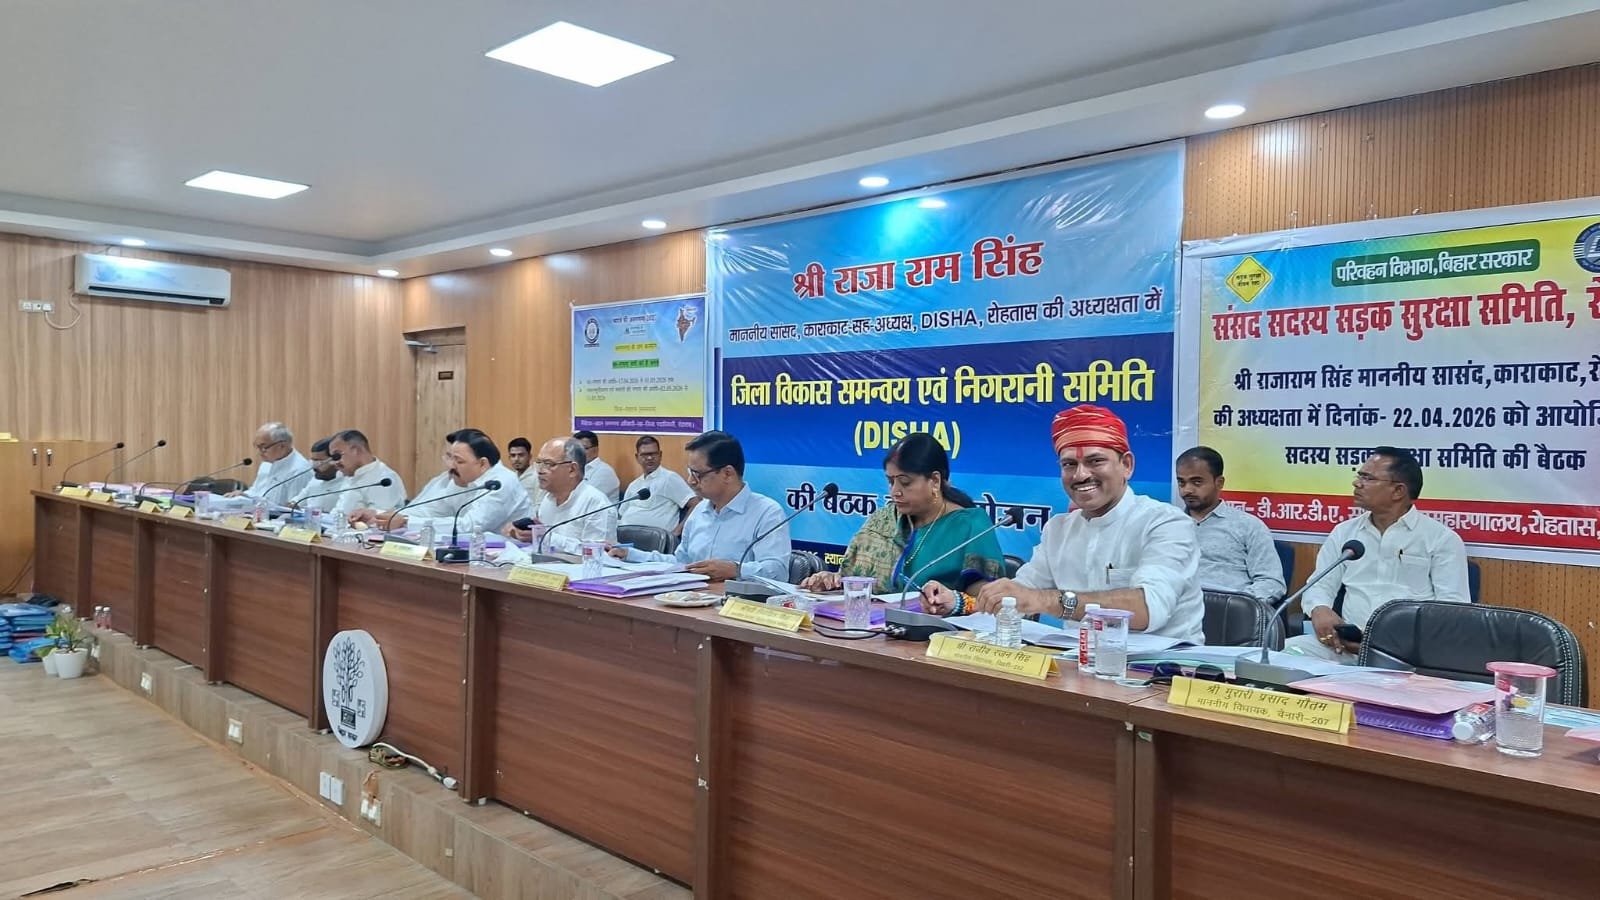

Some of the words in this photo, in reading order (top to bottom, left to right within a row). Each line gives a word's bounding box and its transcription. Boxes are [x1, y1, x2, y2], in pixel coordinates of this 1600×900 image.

[794, 263, 825, 298] श्री
[834, 262, 895, 293] राजा
[906, 253, 961, 286] राम
[972, 236, 1044, 279] सिंह
[1336, 261, 1387, 281] परिवहन
[1479, 248, 1534, 270] सरकार
[729, 323, 767, 342] माननीय
[922, 310, 983, 328] DISHA,
[988, 302, 1037, 323] रोहतास
[1043, 296, 1063, 319] की
[1070, 295, 1140, 317] अध्यक्षता
[1144, 287, 1163, 311] में
[1212, 304, 1262, 340] संसद
[1267, 306, 1330, 337] सदस्य
[1335, 301, 1395, 340] सड़क
[1400, 295, 1472, 341] सुरक्षा
[1478, 280, 1575, 328] समिति,
[731, 374, 770, 406] जिला
[775, 373, 832, 405] विकास
[838, 378, 911, 405] समन्वय
[917, 367, 948, 405] एवं
[955, 363, 1055, 403] निगरानी
[1062, 358, 1155, 402] समिति
[1234, 368, 1252, 390] श्री
[1257, 371, 1317, 389] राजाराम
[1322, 364, 1353, 388] सिंह
[1358, 361, 1427, 387] माननीय
[1213, 405, 1233, 426] की
[1237, 409, 1303, 427] अध्यक्षता
[1307, 404, 1322, 426] में
[1326, 403, 1386, 426] दिनांक-
[1393, 407, 1496, 427] 22.04.2026
[1502, 400, 1530, 426] को
[1285, 446, 1331, 464] सदस्य
[1437, 443, 1497, 468] समिति
[1502, 443, 1530, 469] की
[1534, 443, 1587, 470] बैठक
[787, 483, 816, 511] की
[1206, 684, 1220, 695] श्री
[1259, 692, 1290, 705] प्रसाद
[1296, 696, 1328, 712] गौतम
